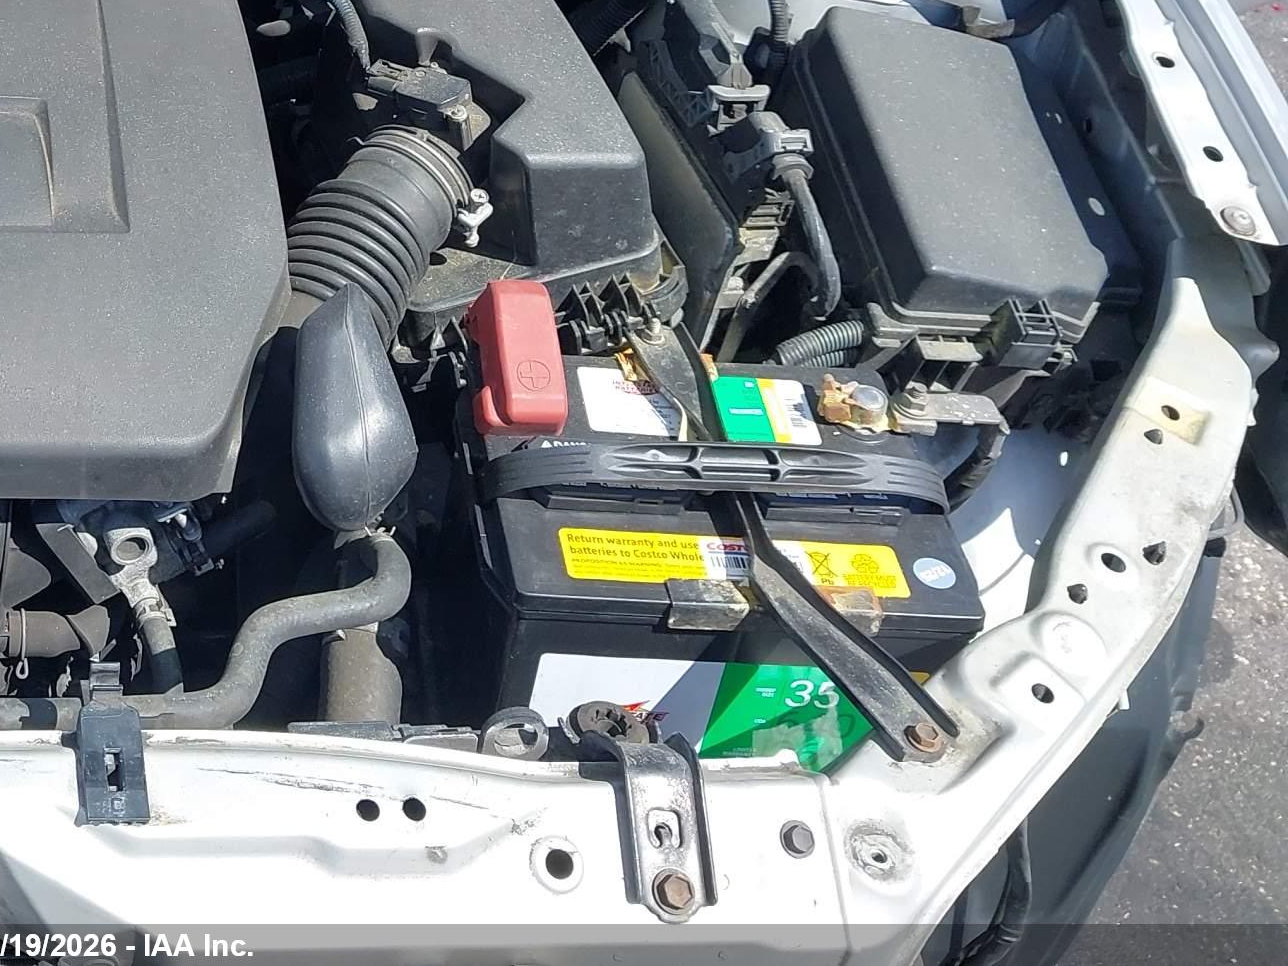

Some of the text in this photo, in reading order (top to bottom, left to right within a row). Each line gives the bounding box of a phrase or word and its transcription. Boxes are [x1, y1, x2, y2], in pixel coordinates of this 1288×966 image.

[567, 533, 700, 550] Return warranty and use
[706, 541, 749, 552] COST
[570, 545, 705, 563] batteries to Costco Whole
[820, 577, 835, 586] Pb
[784, 679, 840, 710] 35
